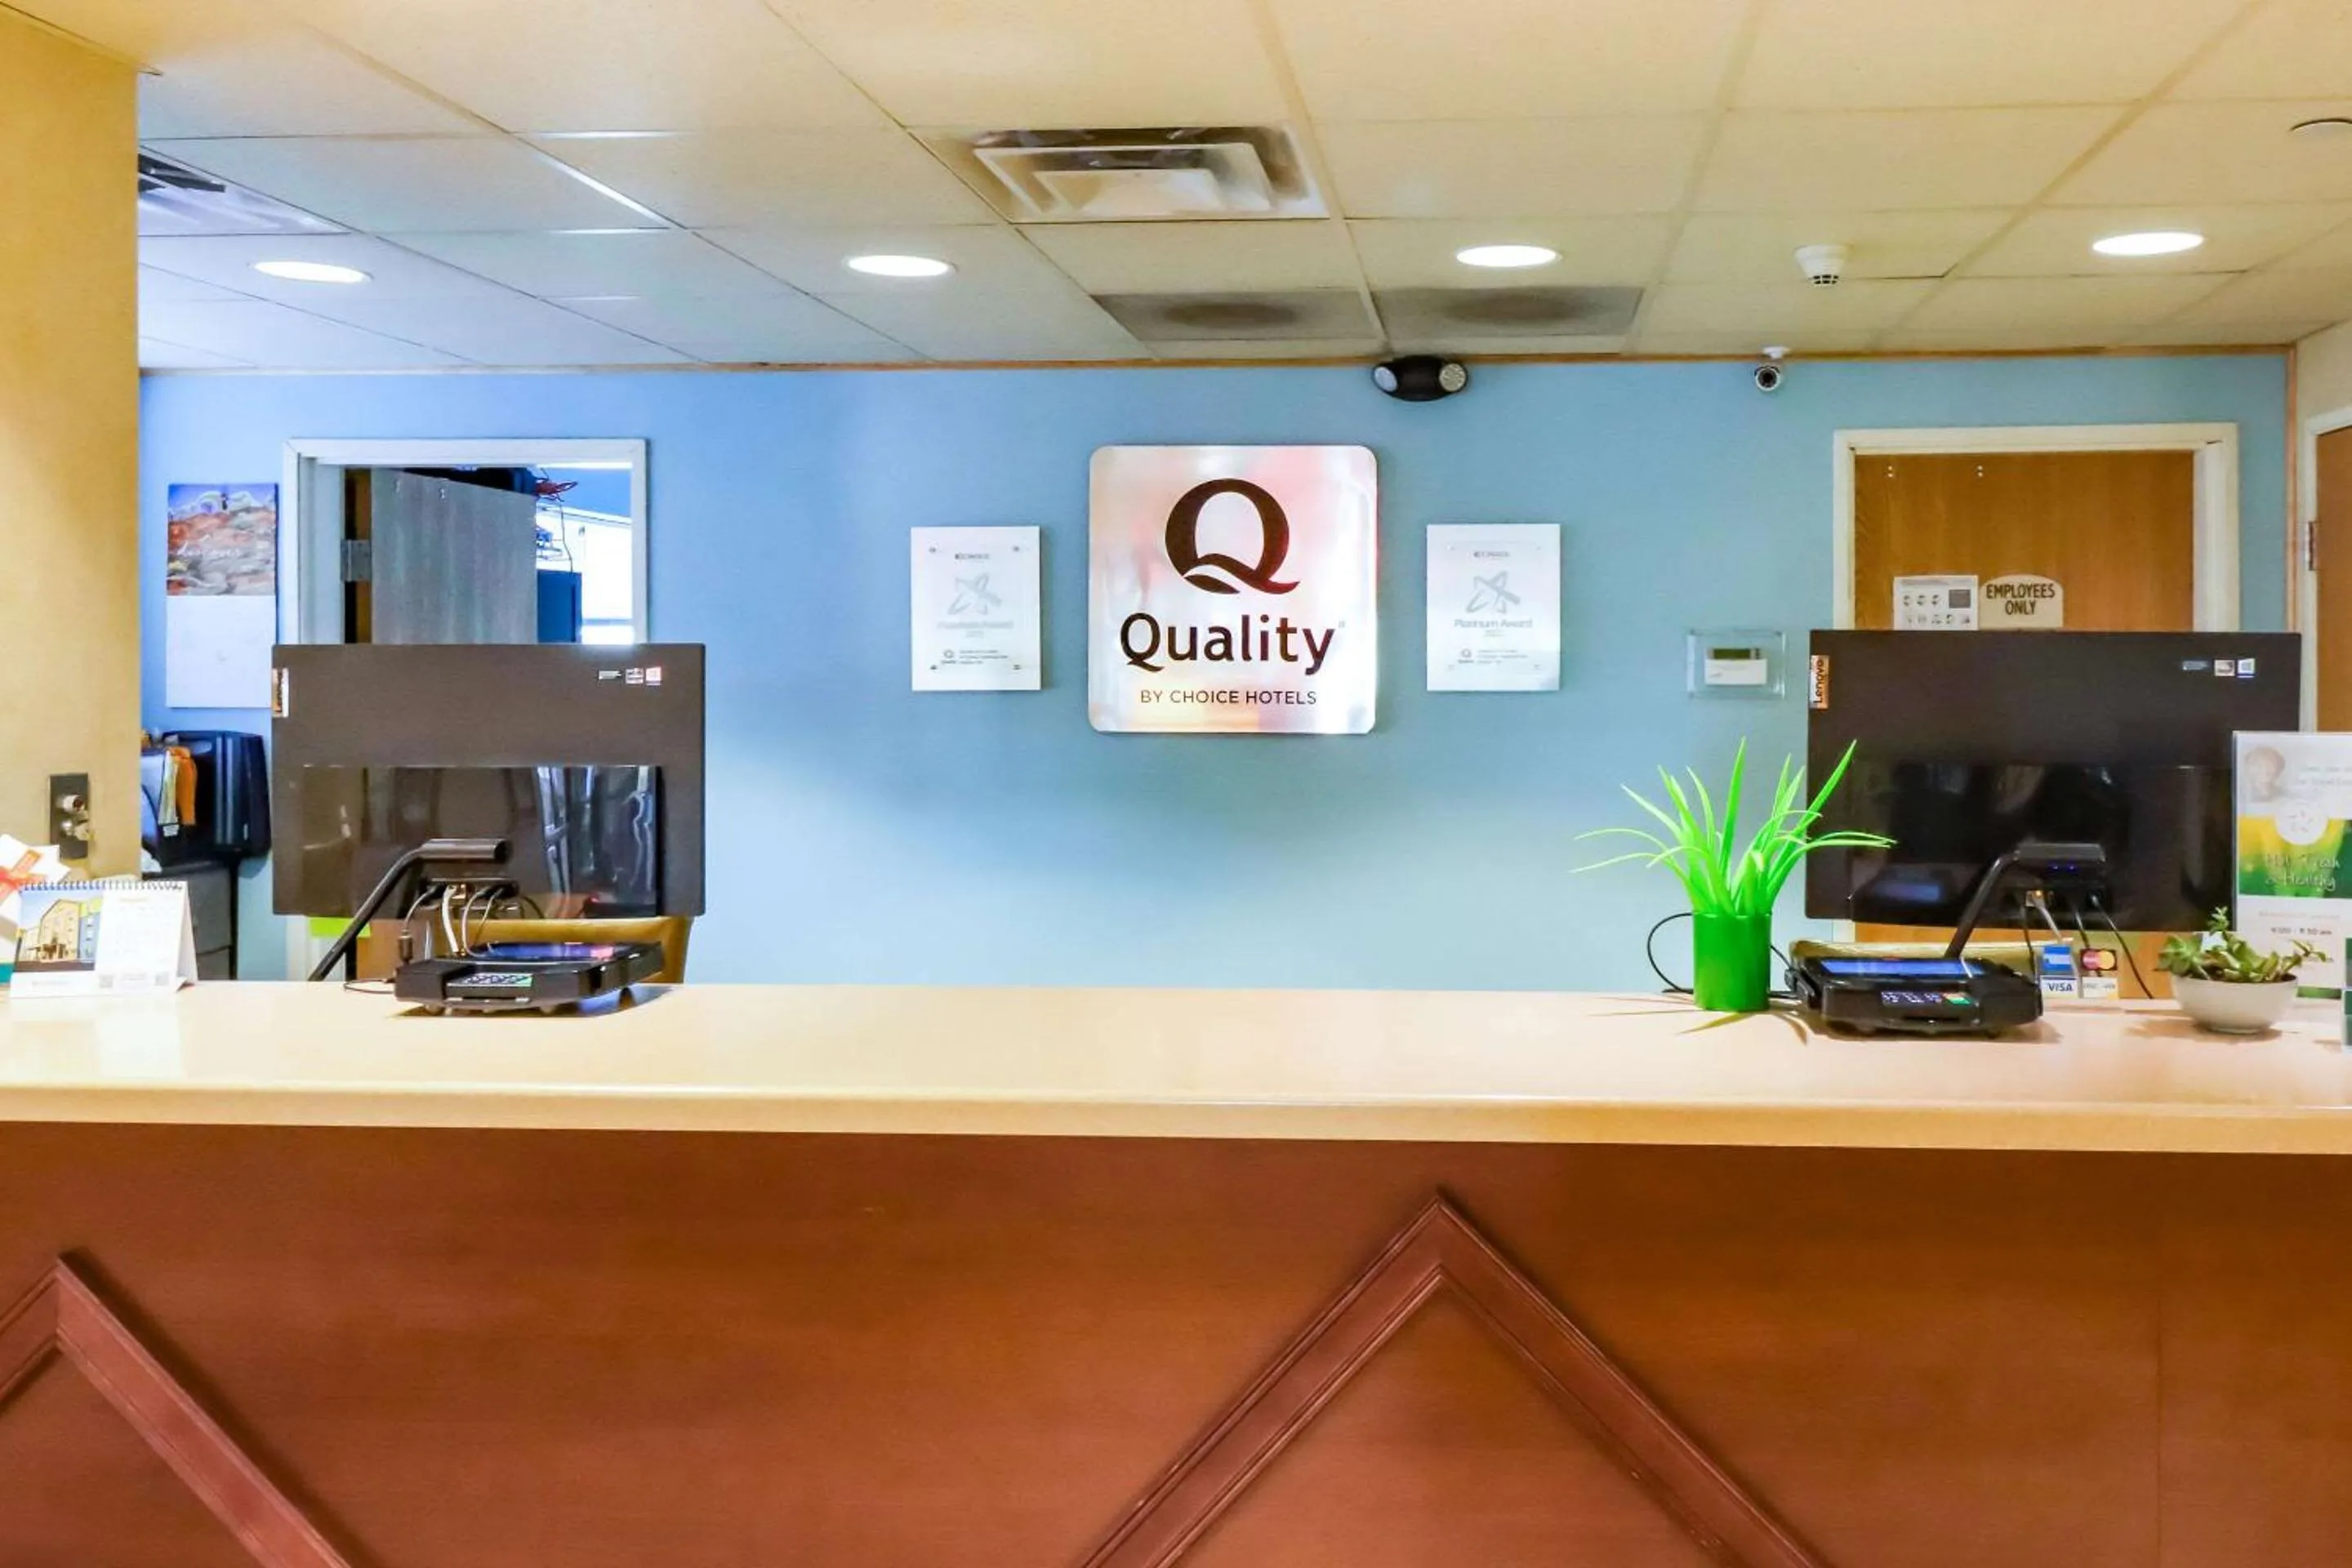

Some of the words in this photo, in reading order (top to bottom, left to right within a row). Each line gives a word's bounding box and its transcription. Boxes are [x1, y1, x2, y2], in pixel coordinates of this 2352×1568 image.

[1165, 478, 1300, 595] Q
[1985, 582, 2056, 599] EMPLOYEES
[2004, 600, 2037, 616] ONLY
[1120, 612, 1335, 676] Quality
[1813, 659, 1825, 702] Lenovo
[1140, 690, 1163, 703] BY
[1169, 690, 1240, 704] CHOICE
[1246, 690, 1317, 705] HOTELS
[2047, 982, 2074, 992] VISA
